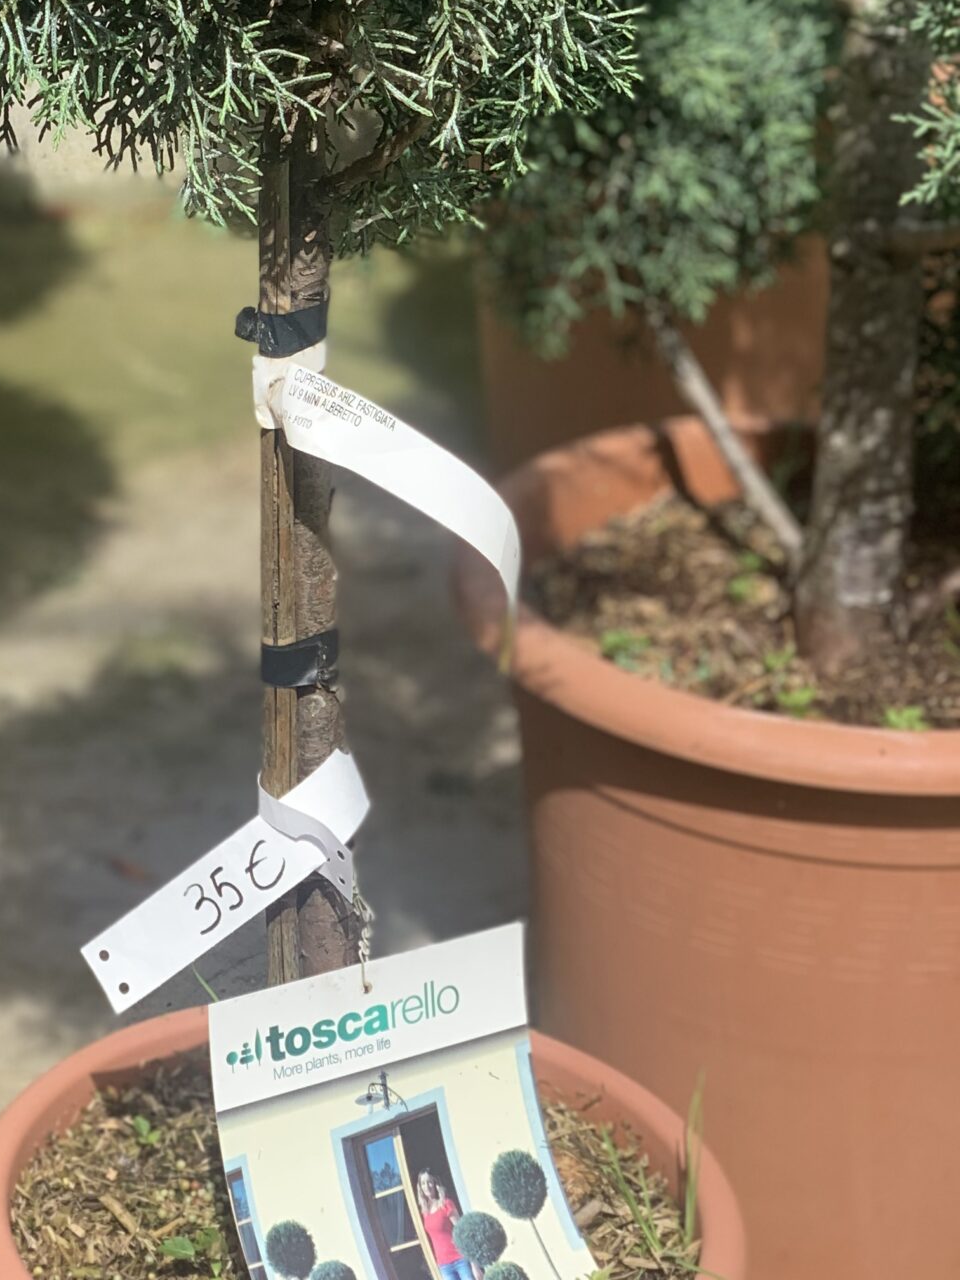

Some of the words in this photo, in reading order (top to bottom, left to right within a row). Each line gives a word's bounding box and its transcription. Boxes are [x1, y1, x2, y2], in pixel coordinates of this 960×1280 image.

[294, 368, 339, 398] CUPRESSUS
[356, 399, 396, 432] FASTIGIATA
[320, 398, 362, 428] ALBERETTO
[266, 980, 460, 1062] toscarello
[273, 1061, 303, 1081] More
[305, 1050, 342, 1075] plants,
[344, 1042, 374, 1060] more
[376, 1037, 391, 1052] life
